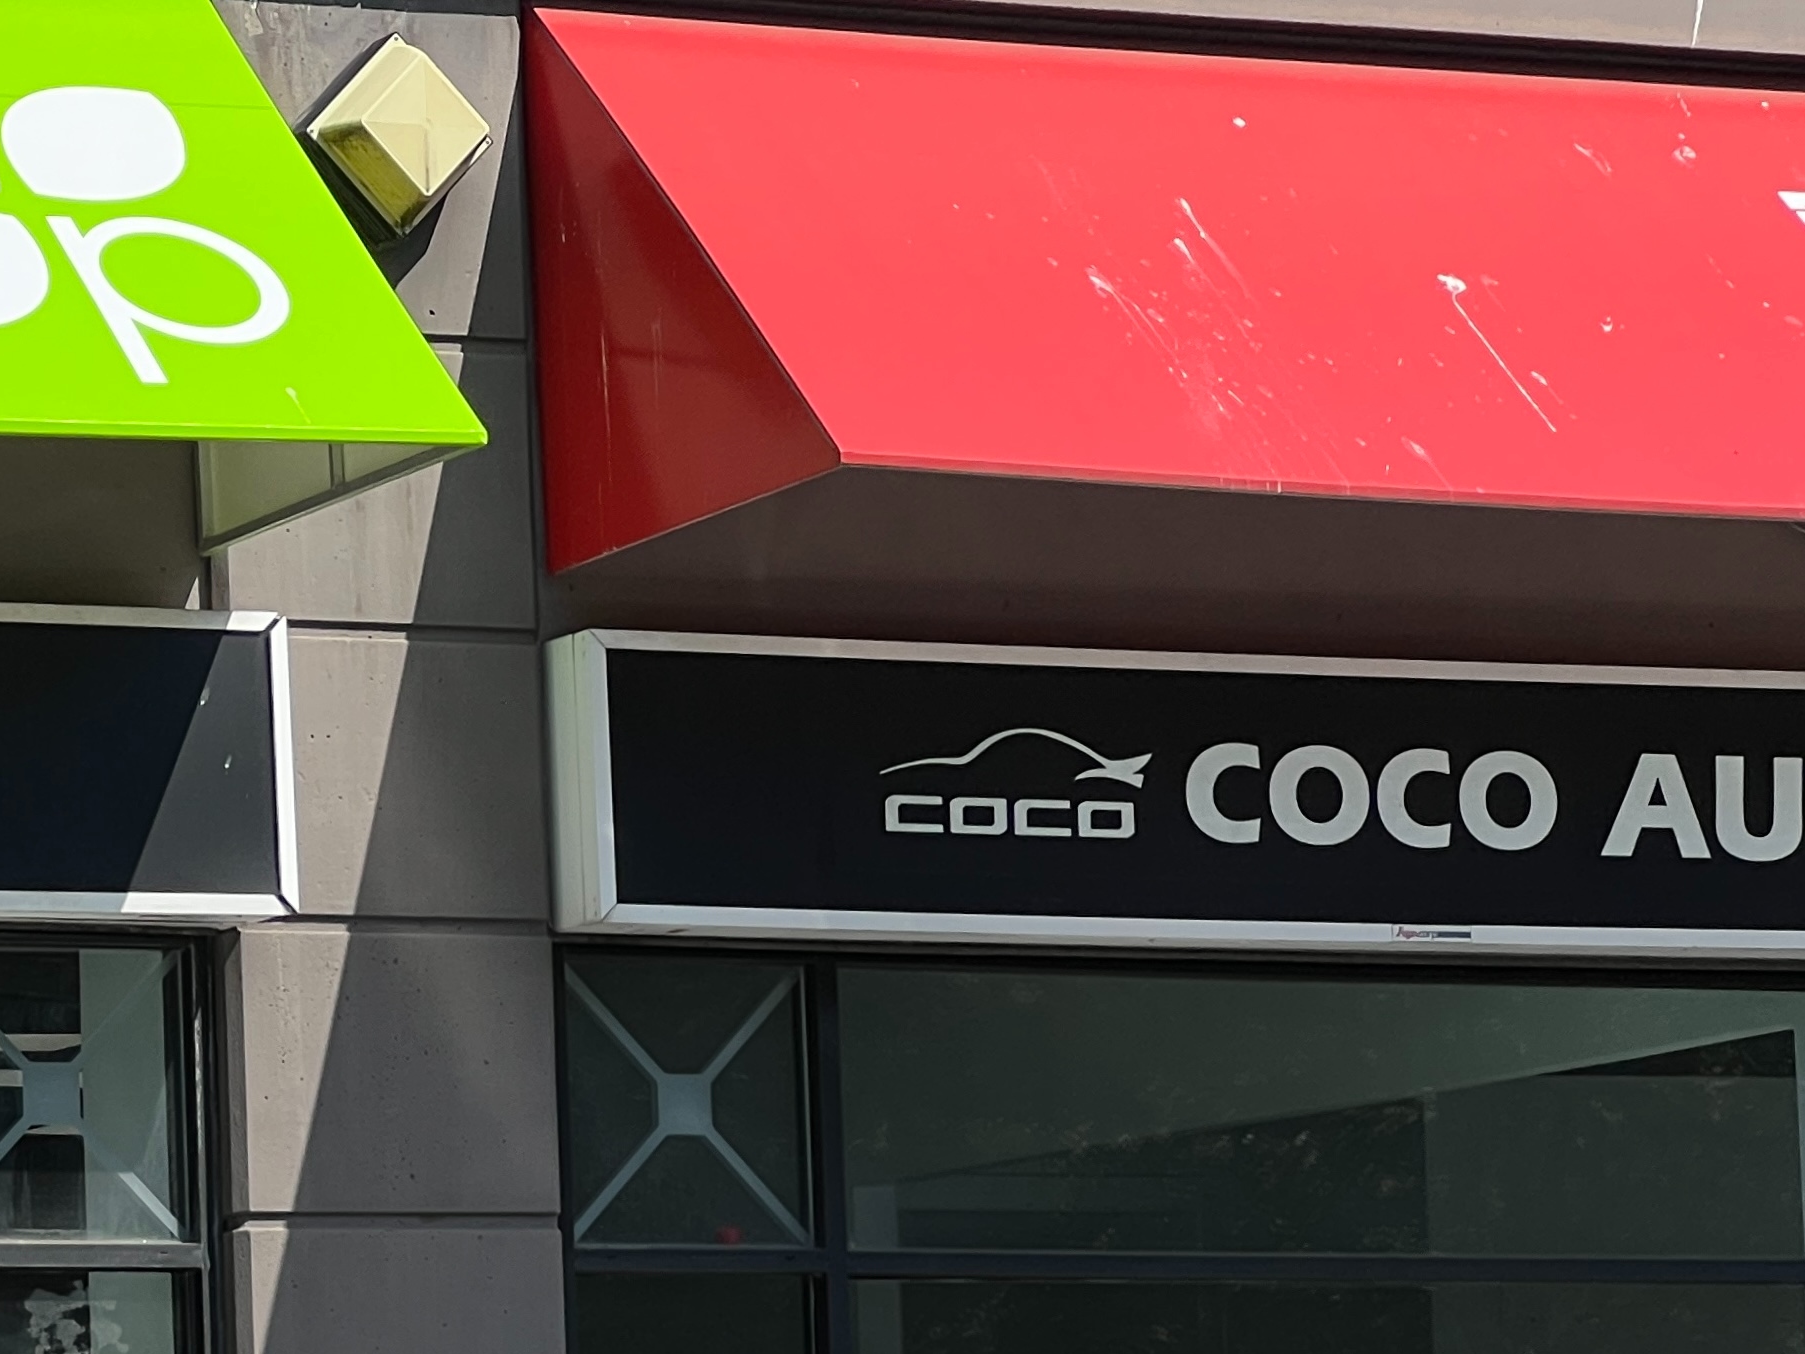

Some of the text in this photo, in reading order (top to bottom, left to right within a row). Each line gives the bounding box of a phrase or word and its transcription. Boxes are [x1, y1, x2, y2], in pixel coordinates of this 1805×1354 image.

[884, 794, 1136, 839] COCO
[1185, 742, 1803, 862] COCO AU
